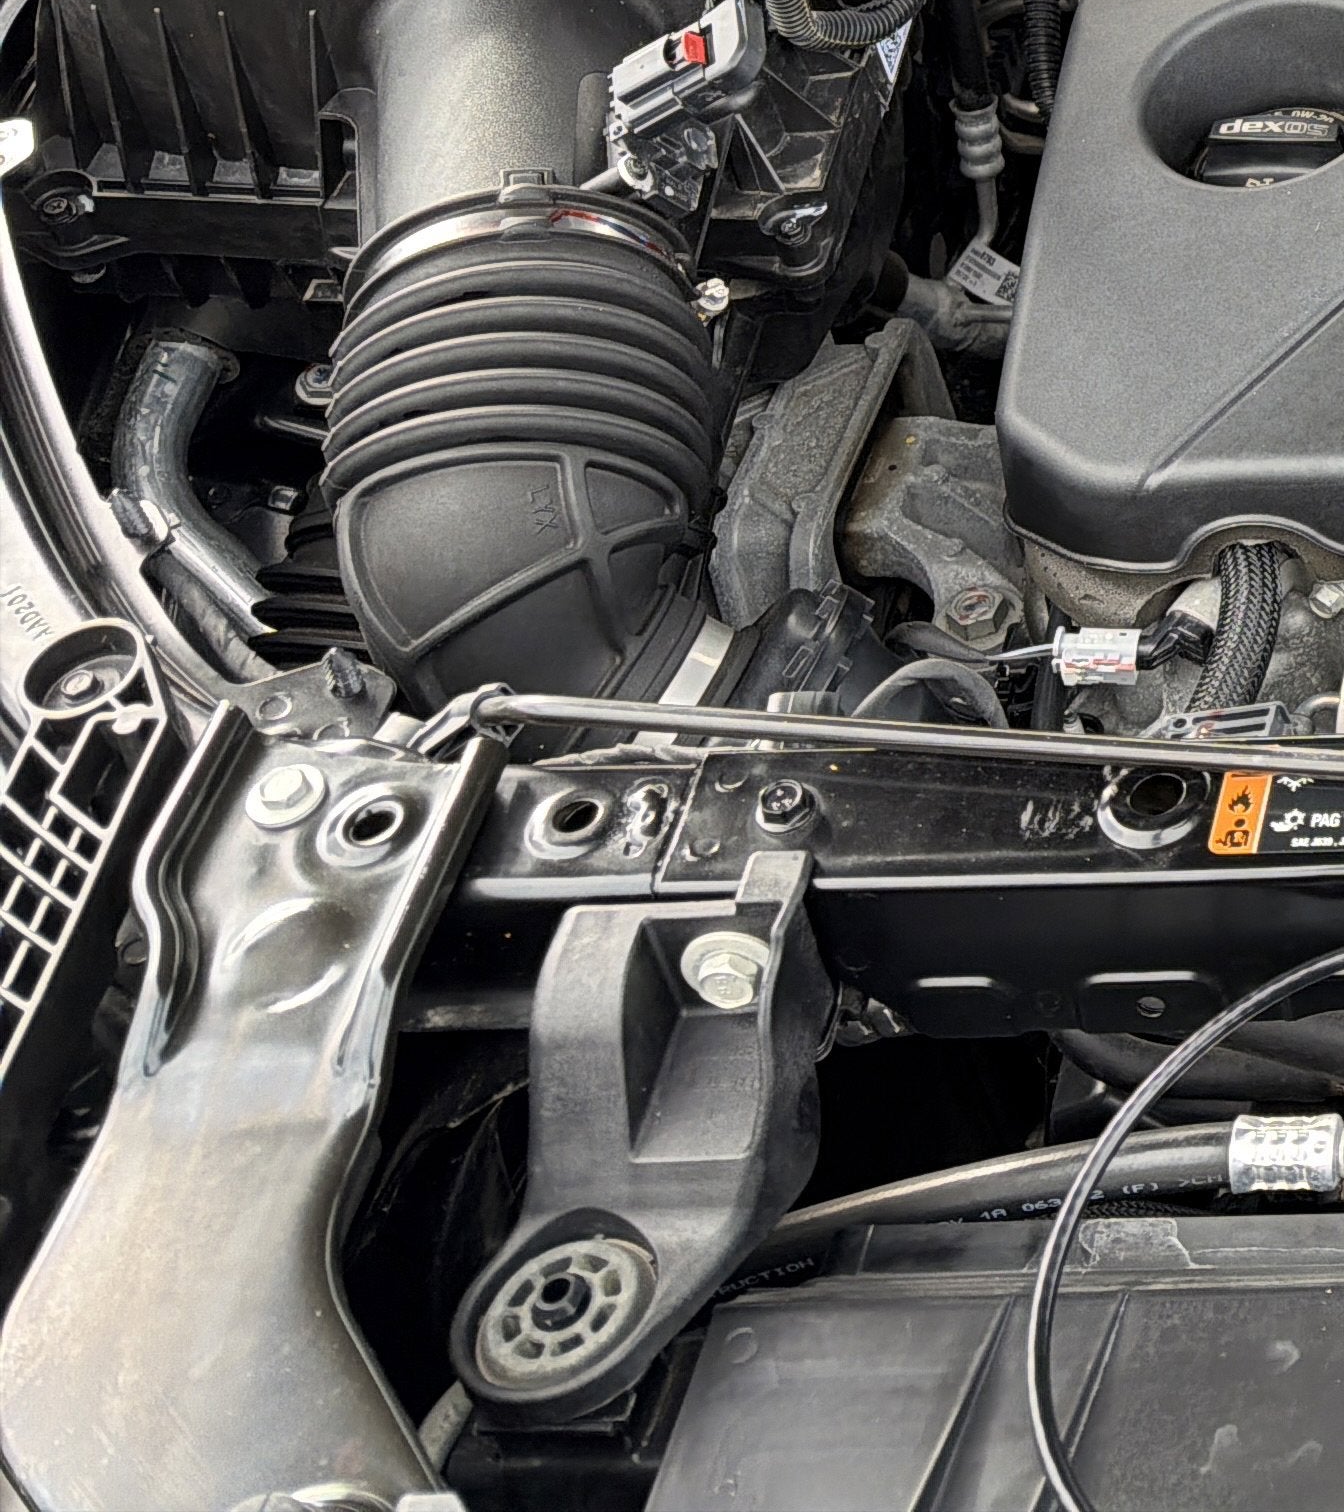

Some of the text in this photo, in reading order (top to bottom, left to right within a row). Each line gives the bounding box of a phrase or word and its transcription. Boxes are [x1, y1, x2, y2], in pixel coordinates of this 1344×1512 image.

[1219, 118, 1329, 137] dexos
[1310, 812, 1341, 828] PAG
[712, 1257, 815, 1298] RUCTION
